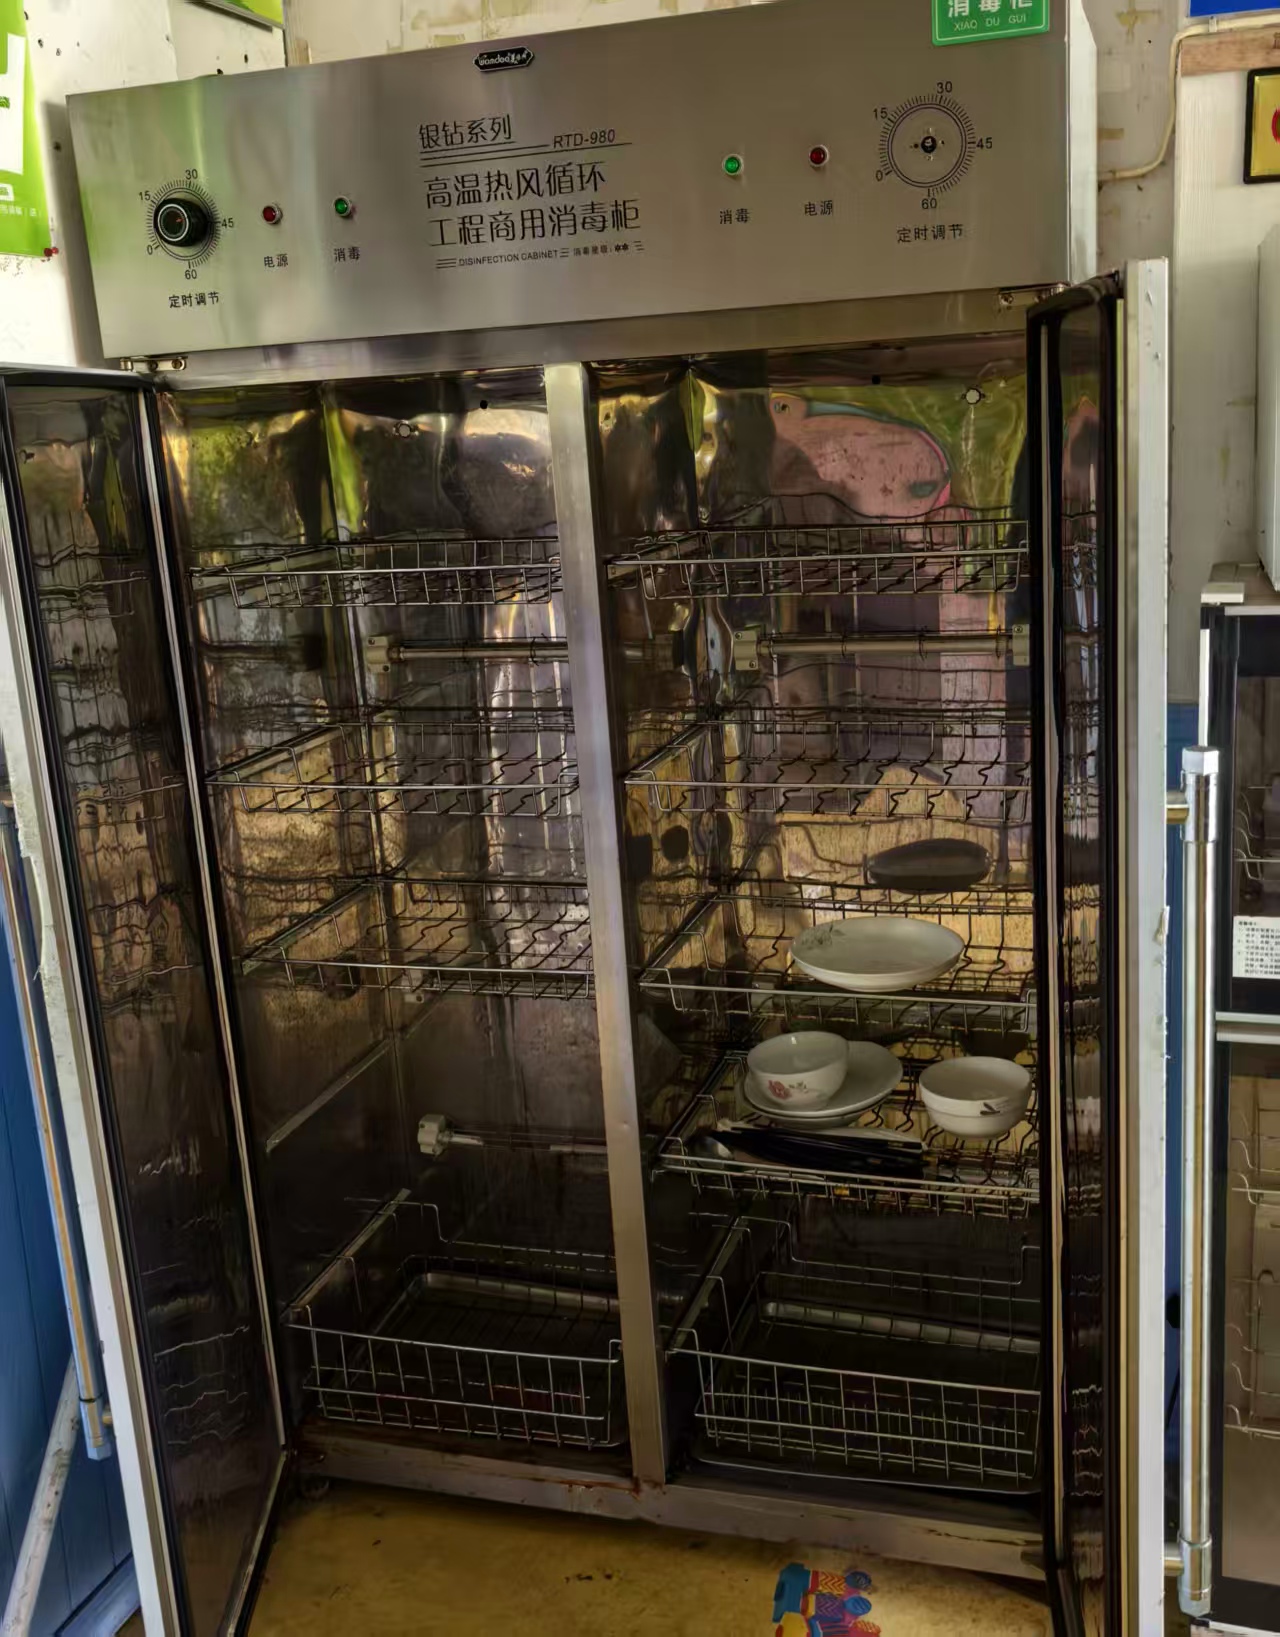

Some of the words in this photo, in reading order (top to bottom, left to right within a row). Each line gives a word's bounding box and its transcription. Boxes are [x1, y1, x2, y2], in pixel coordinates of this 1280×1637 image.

[953, 20, 978, 31] XIAO
[985, 17, 1000, 27] DU
[1008, 14, 1026, 24] GUI
[936, 80, 953, 94] 30
[873, 107, 888, 120] 15
[418, 114, 512, 149] 银钻系列
[553, 129, 616, 148] RTD-980
[976, 137, 993, 149] 45
[185, 169, 198, 180] 30
[875, 170, 883, 182] 0
[424, 161, 606, 209] 高温热风循环
[138, 190, 151, 201] 15
[804, 200, 833, 216] 电源
[921, 198, 937, 209] 60
[221, 218, 234, 228] 45
[428, 199, 641, 247] 工程商用消毒柜
[720, 208, 749, 224] 消毒
[897, 224, 963, 243] 定时调节
[146, 245, 153, 255] 0
[333, 246, 360, 262] 消毒
[458, 253, 519, 266] DISINFECTION
[521, 249, 558, 260] CABINET
[263, 253, 288, 268] 电源
[185, 269, 197, 280] 60
[168, 291, 219, 308] 定时调节
